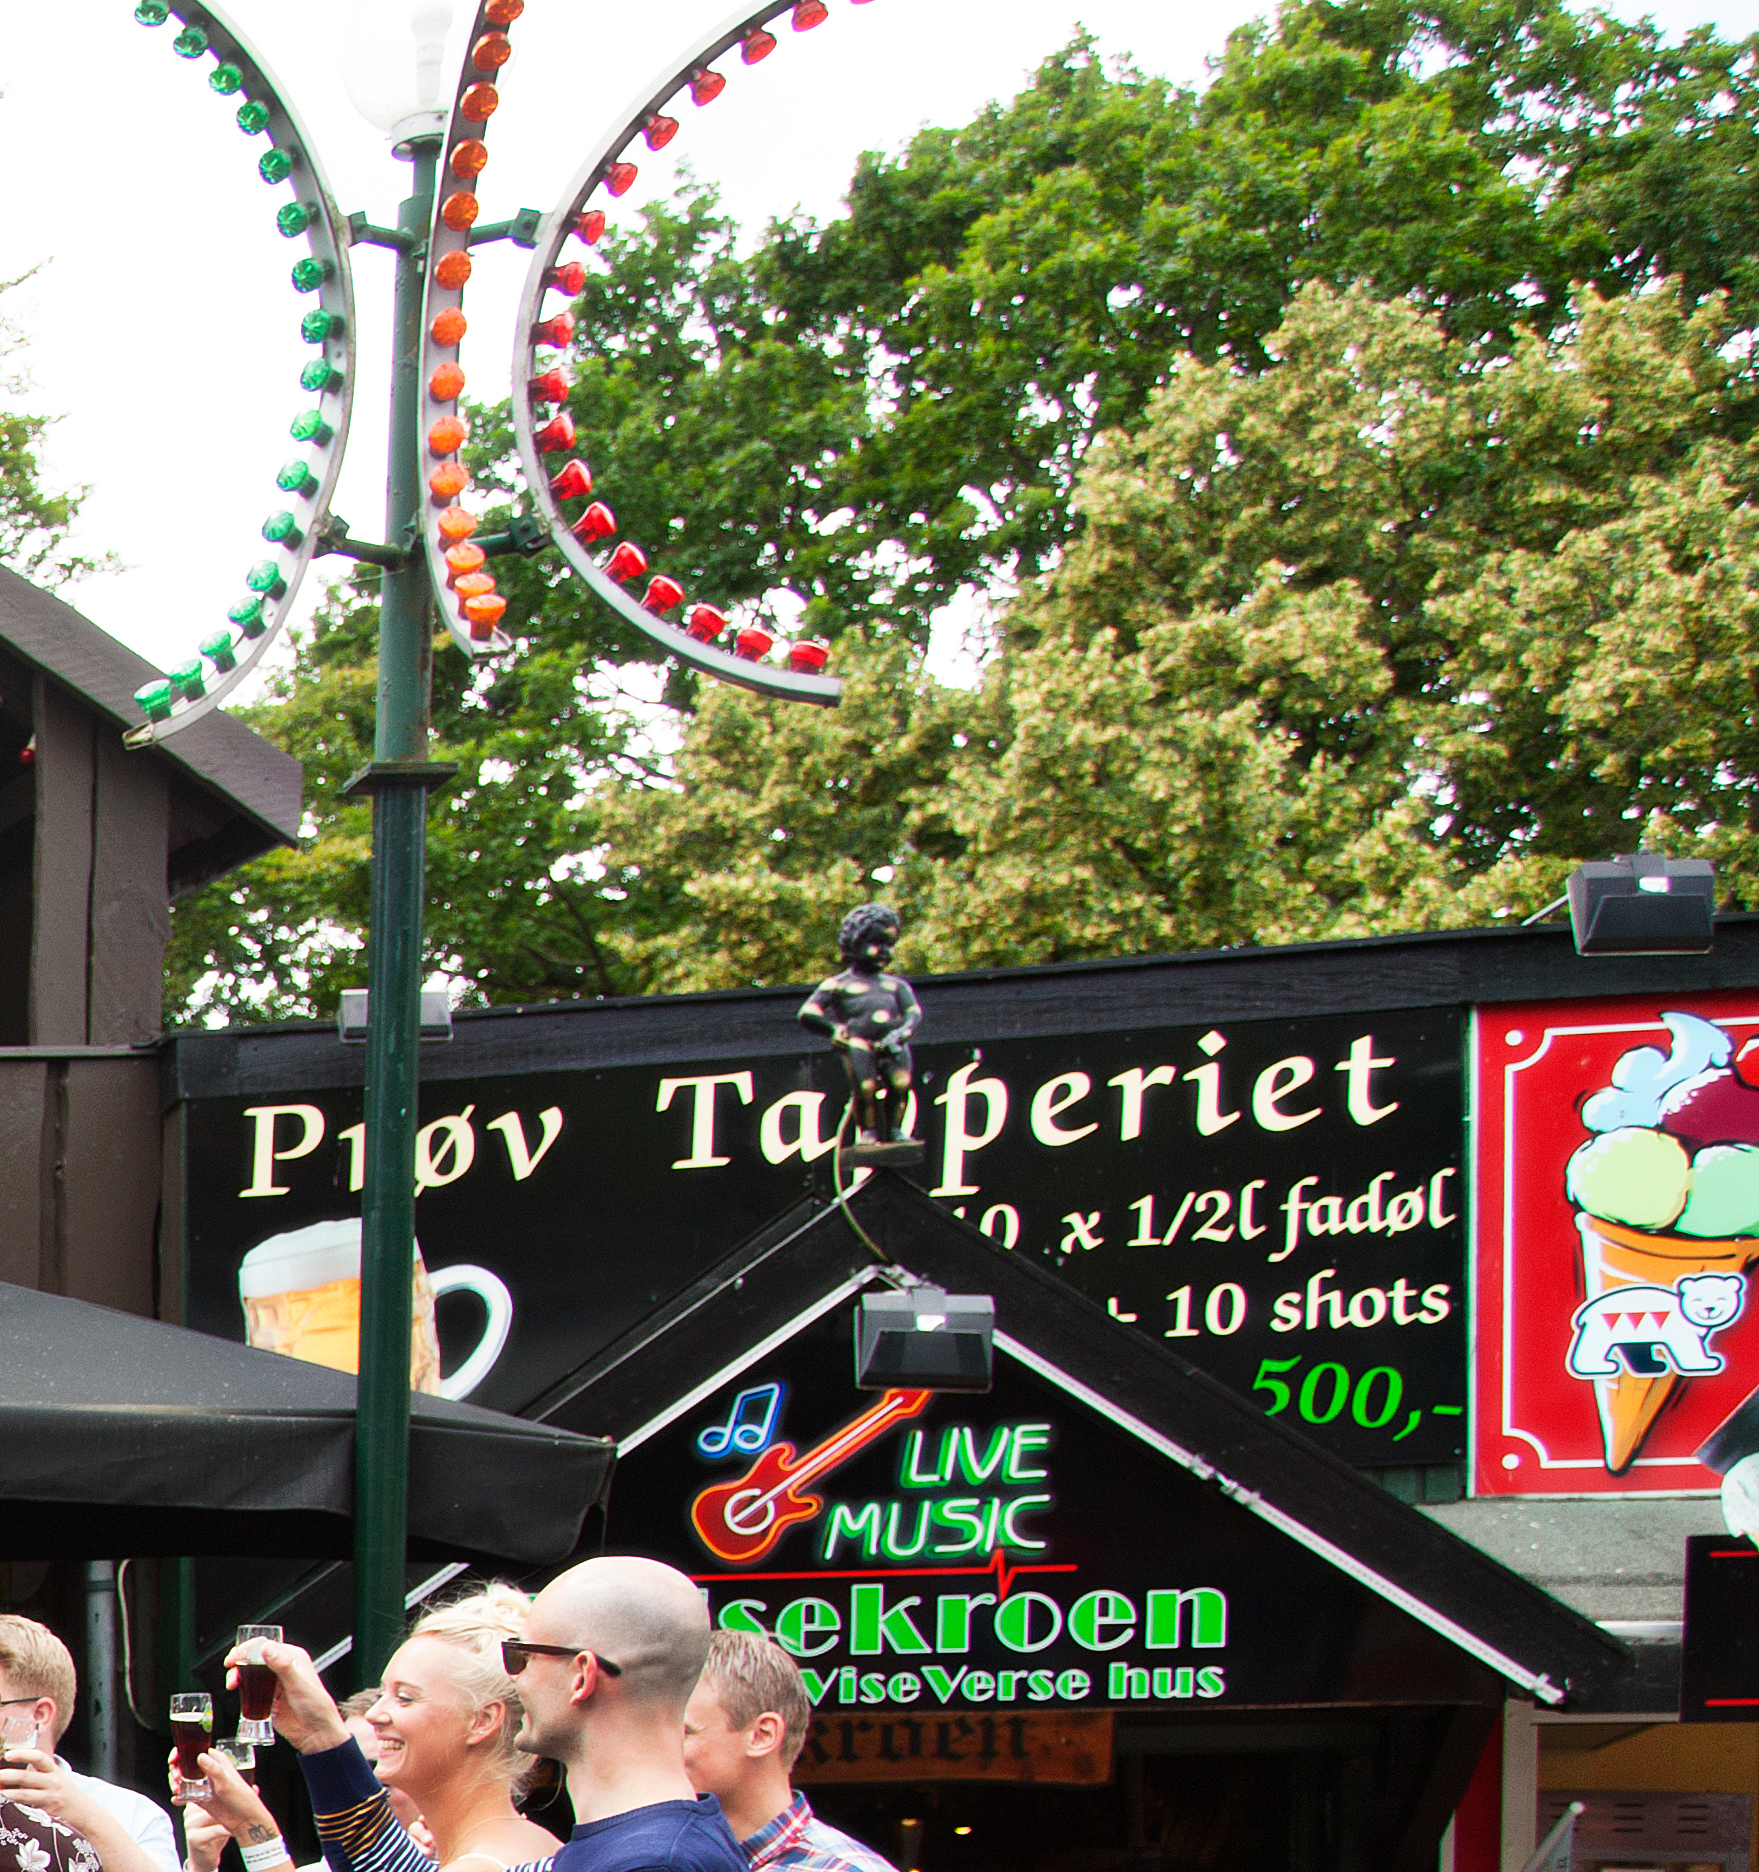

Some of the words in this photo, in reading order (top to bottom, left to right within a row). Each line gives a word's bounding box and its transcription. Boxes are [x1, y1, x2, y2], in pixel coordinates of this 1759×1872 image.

[953, 1203, 1020, 1250] 0
[1060, 1211, 1105, 1254] x
[1268, 1166, 1457, 1262] fadøl
[1164, 1282, 1248, 1338] 10
[1270, 1270, 1451, 1334] shots
[1251, 1355, 1463, 1441] 500,-
[901, 1424, 1052, 1488] LIVE
[822, 1494, 1052, 1562] MUSIC
[701, 1583, 1227, 1656] sekroen
[1108, 1662, 1226, 1700] hus
